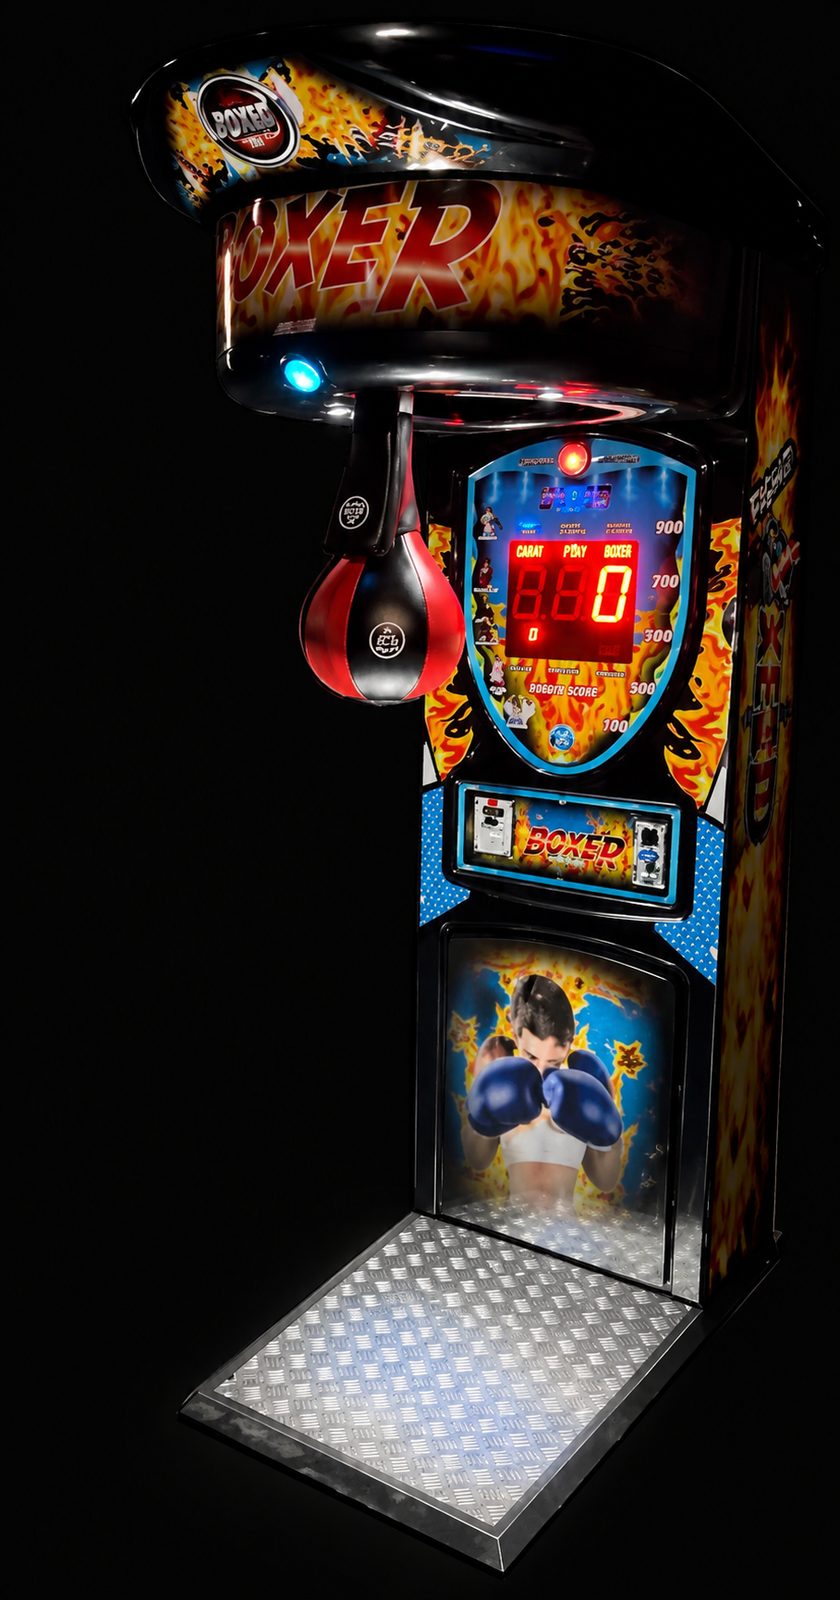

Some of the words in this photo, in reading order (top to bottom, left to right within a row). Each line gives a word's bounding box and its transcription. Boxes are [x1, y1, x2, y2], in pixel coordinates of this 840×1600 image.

[655, 520, 684, 535] 900
[516, 544, 544, 558] CARAT
[563, 543, 588, 558] PLAY
[603, 544, 632, 559] BOXER
[651, 574, 679, 589] 700
[567, 686, 598, 698] SCORE
[603, 719, 629, 734] 100
